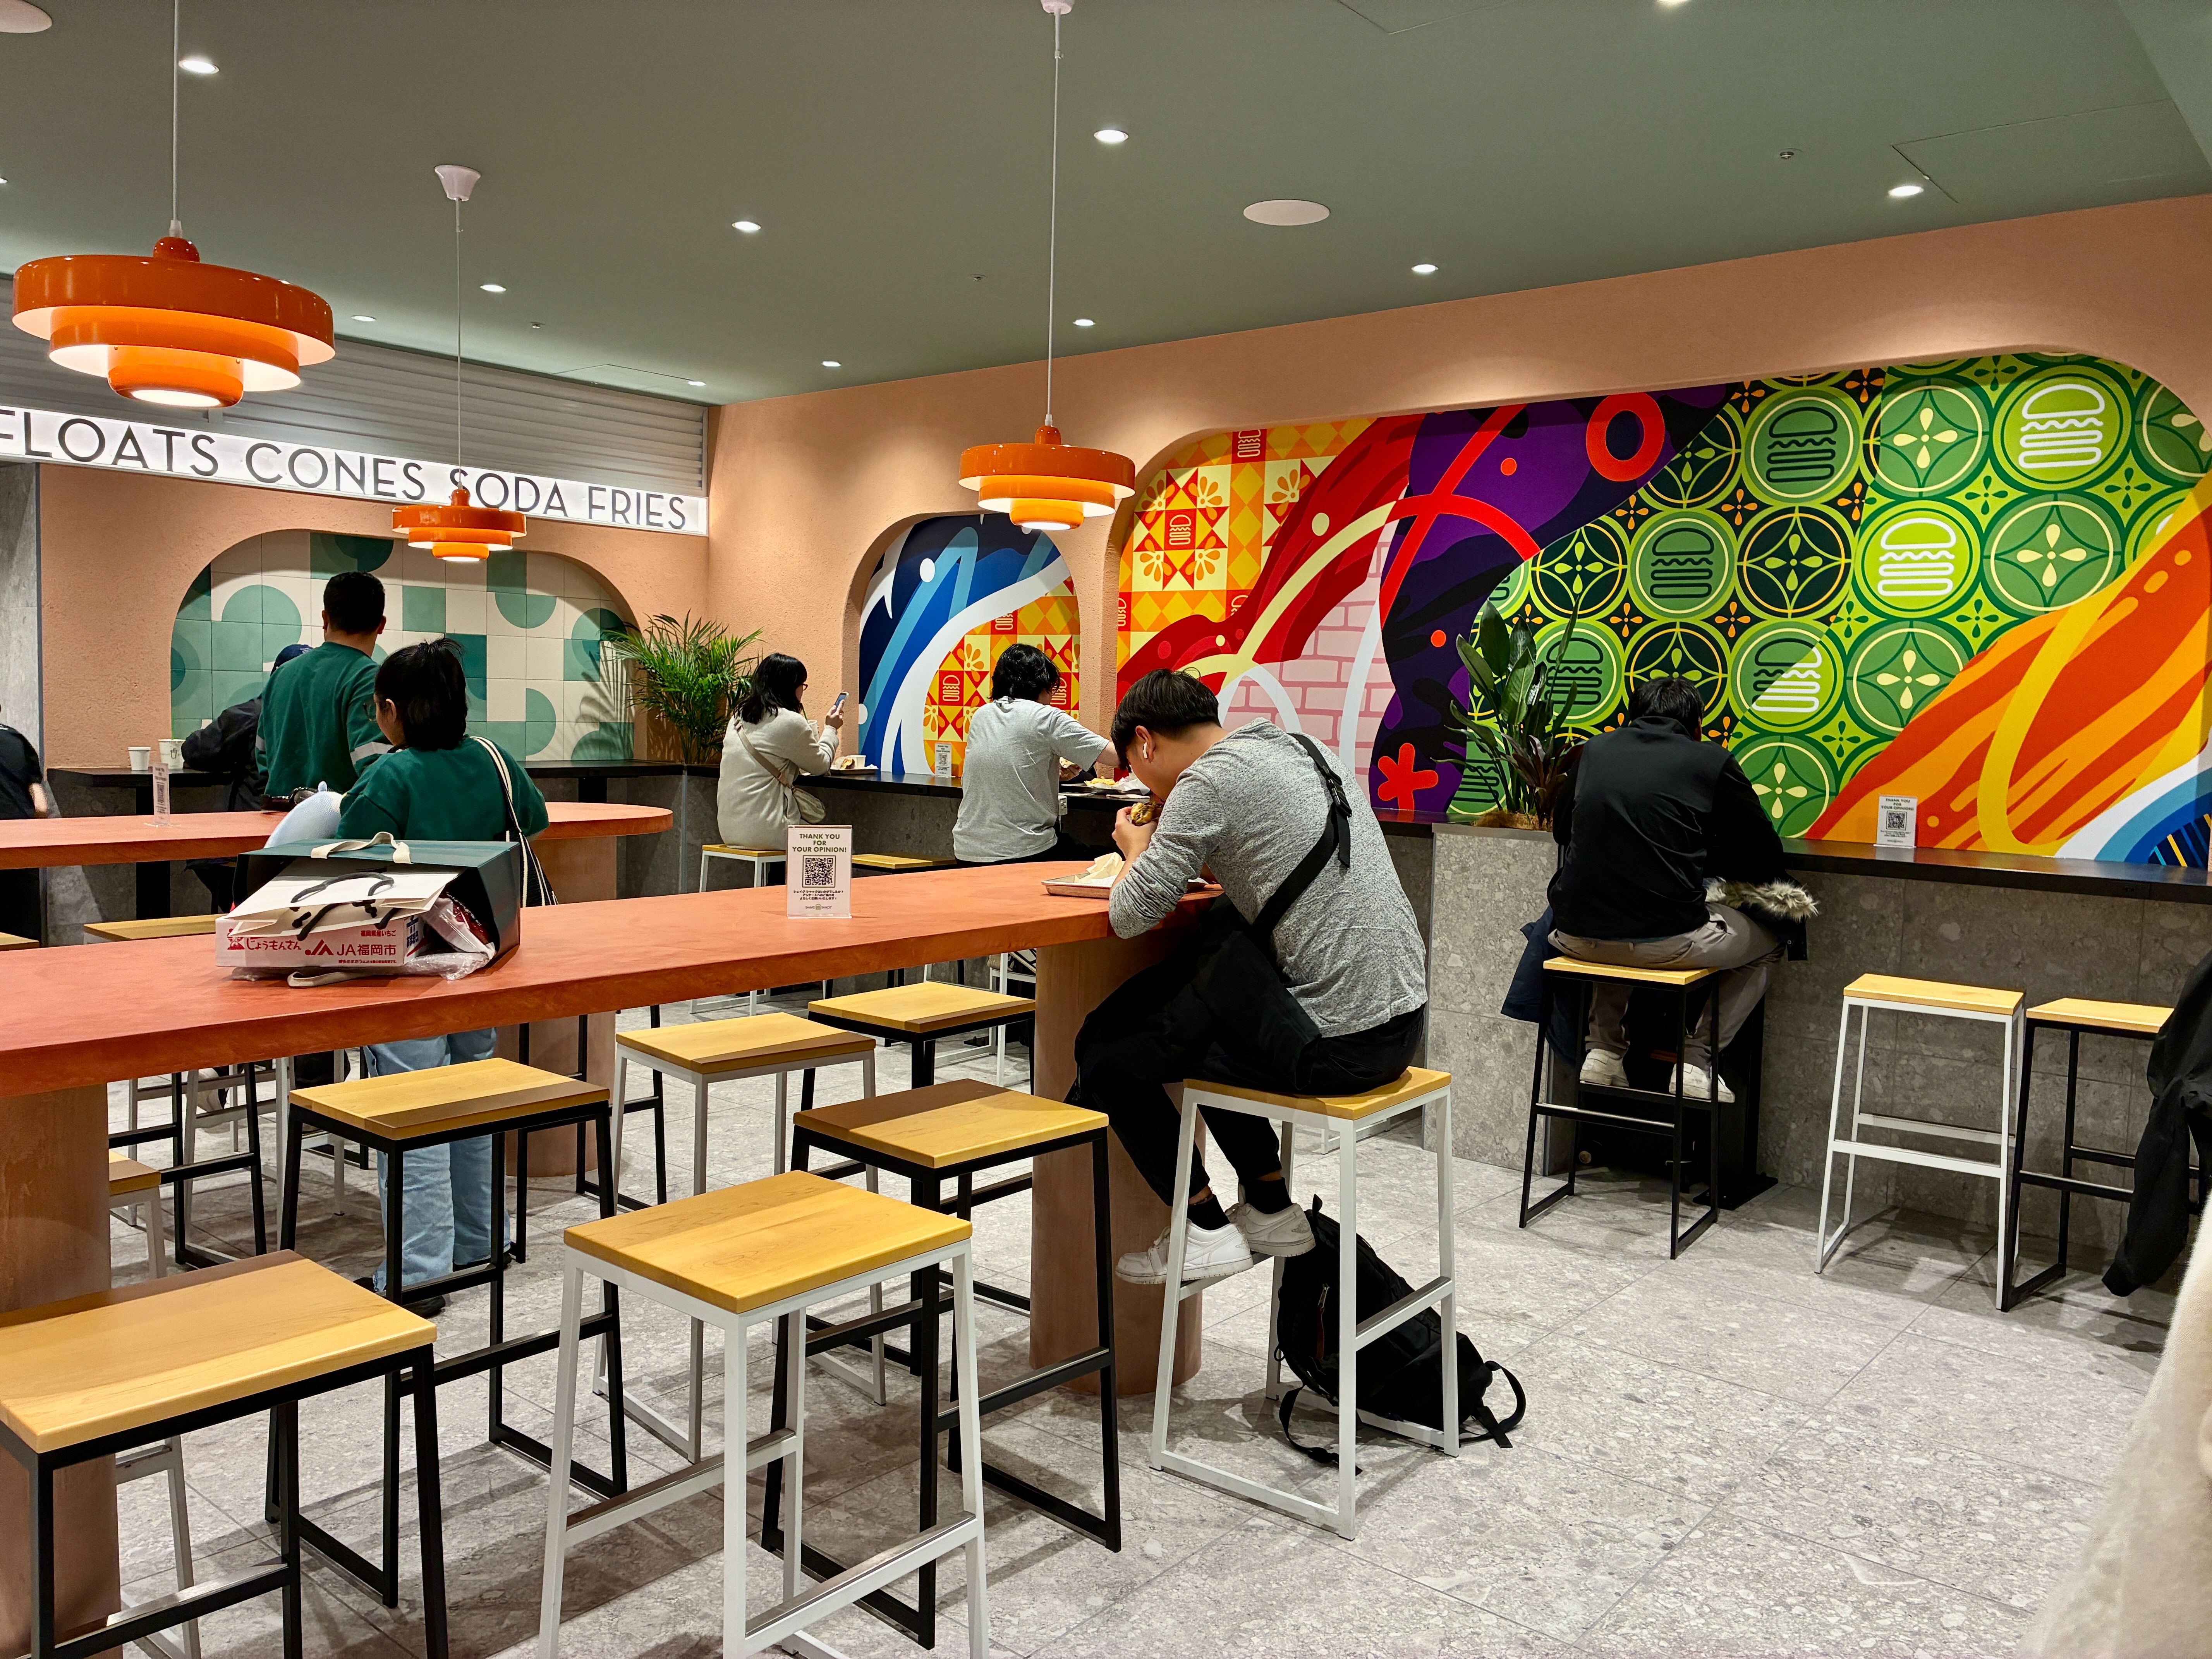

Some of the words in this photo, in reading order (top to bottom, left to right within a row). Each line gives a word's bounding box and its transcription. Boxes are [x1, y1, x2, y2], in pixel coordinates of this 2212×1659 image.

[246, 443, 425, 500] CONES
[448, 468, 568, 517] SODA
[588, 486, 686, 530] FRIES
[246, 938, 302, 950] じょうもんさん
[337, 944, 397, 956] JA福岡市
